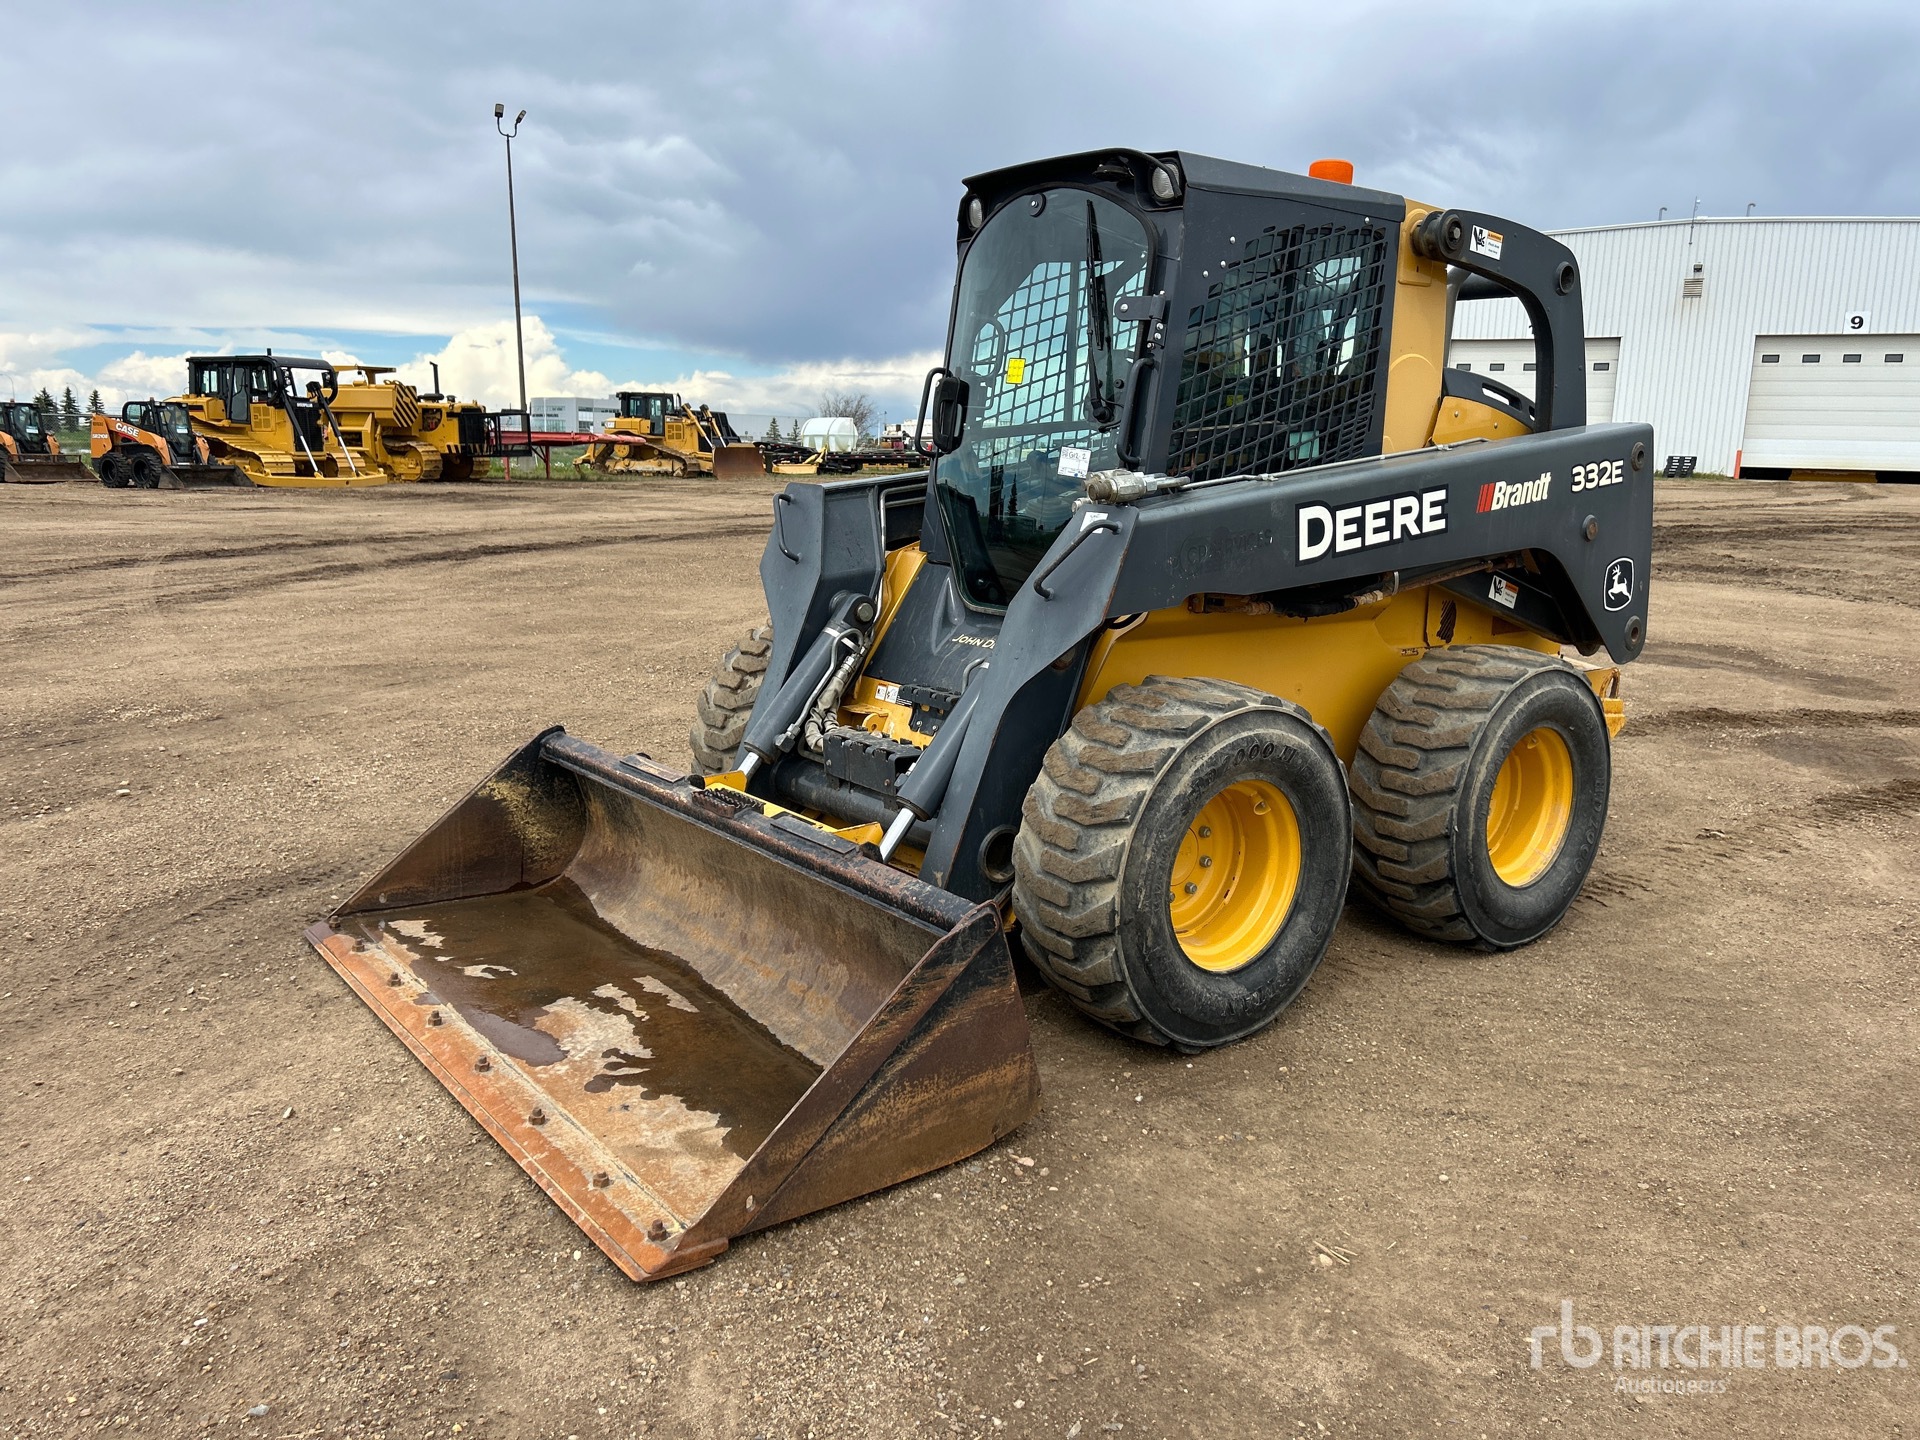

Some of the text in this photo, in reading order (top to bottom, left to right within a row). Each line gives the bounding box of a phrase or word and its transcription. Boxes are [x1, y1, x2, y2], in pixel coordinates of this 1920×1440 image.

[1850, 315, 1864, 330] 9
[115, 423, 139, 437] CASE
[1570, 460, 1624, 493] 332E
[1491, 471, 1552, 511] Brandt
[1298, 489, 1447, 561] DEERE
[951, 633, 984, 647] JOHN
